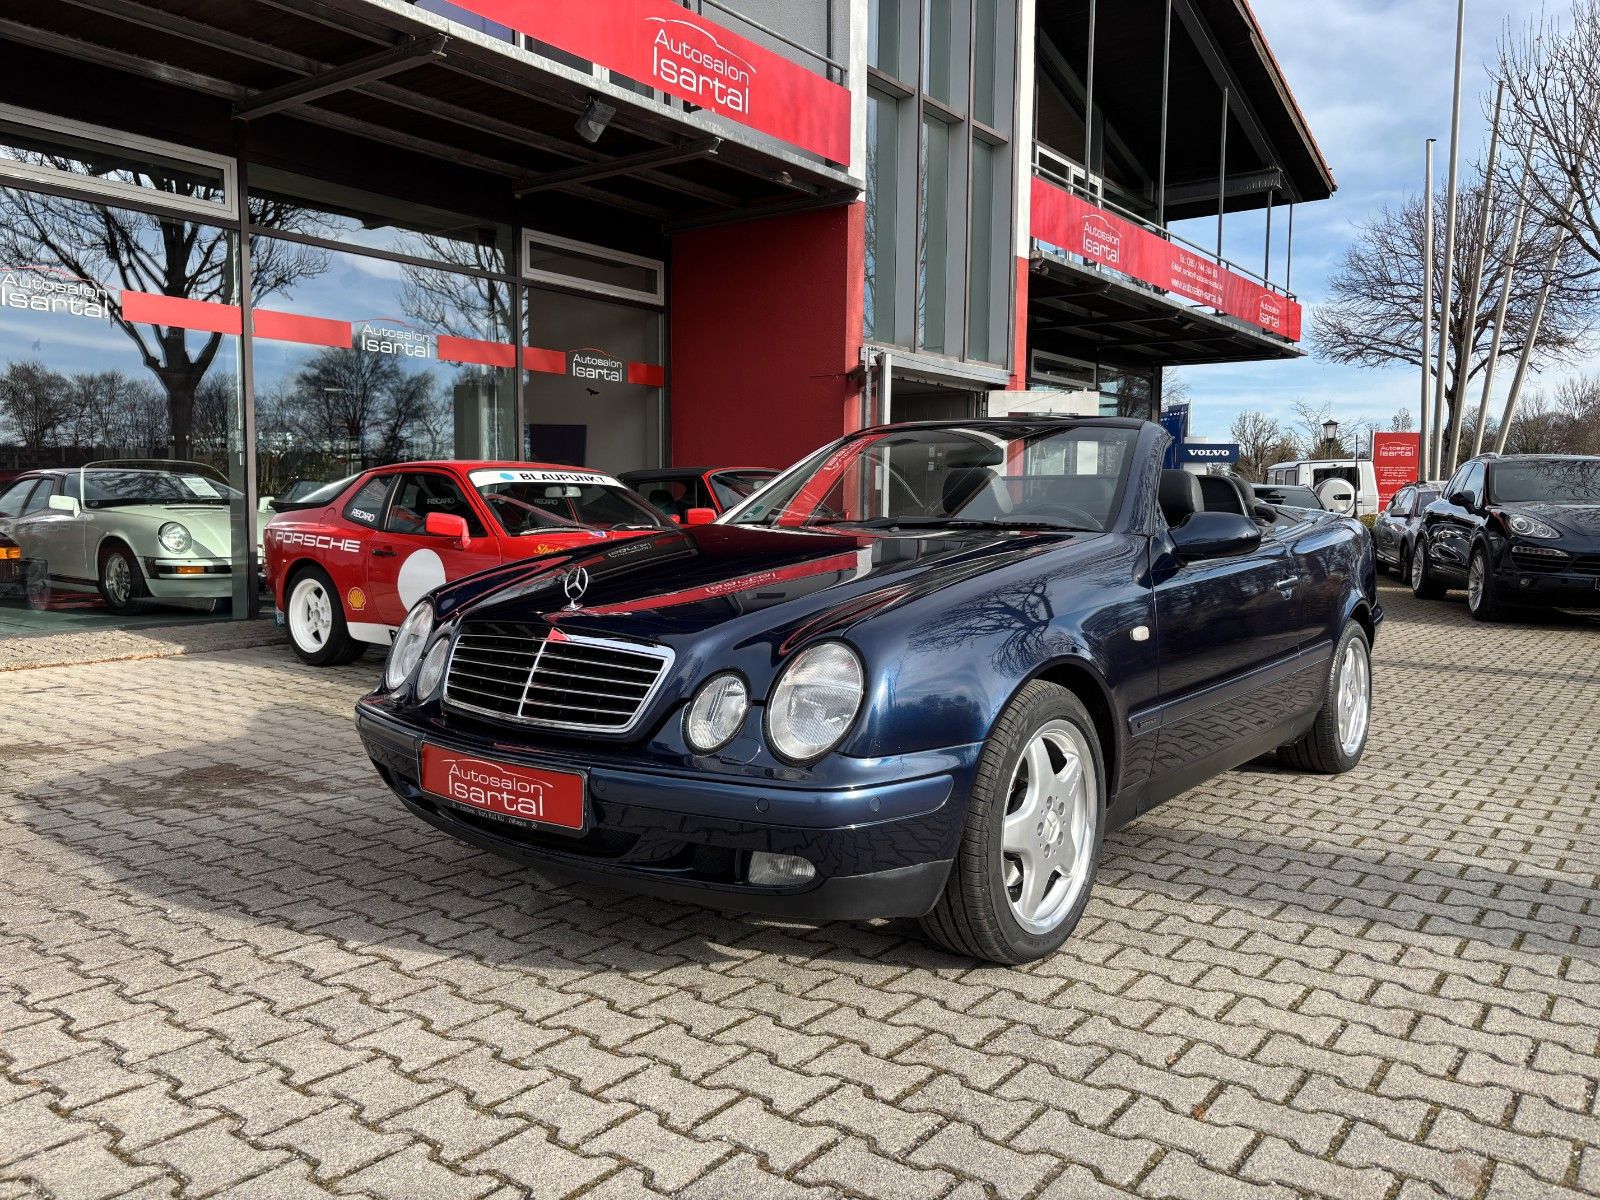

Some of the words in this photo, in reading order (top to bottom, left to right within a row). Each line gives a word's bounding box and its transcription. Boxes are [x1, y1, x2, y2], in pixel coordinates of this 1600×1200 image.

[654, 28, 749, 86] Autosalon
[653, 46, 749, 115] Isartal
[1084, 221, 1120, 247] Autosalon
[1082, 231, 1120, 264] Isartal
[1, 272, 108, 299] Autosalon
[1, 286, 109, 319] Isartal
[362, 323, 431, 342] Autosalon
[361, 334, 431, 358] Isartal
[572, 362, 623, 382] Isartal
[573, 353, 623, 369] Autosalon
[1187, 449, 1230, 457] VOLVO
[519, 472, 607, 484] BLAUPUNKT
[427, 497, 455, 505] RECARO
[351, 508, 375, 522] RECARO
[275, 531, 361, 553] PORSCHE
[449, 763, 543, 796] Autosalon
[448, 774, 544, 817] Isartal
